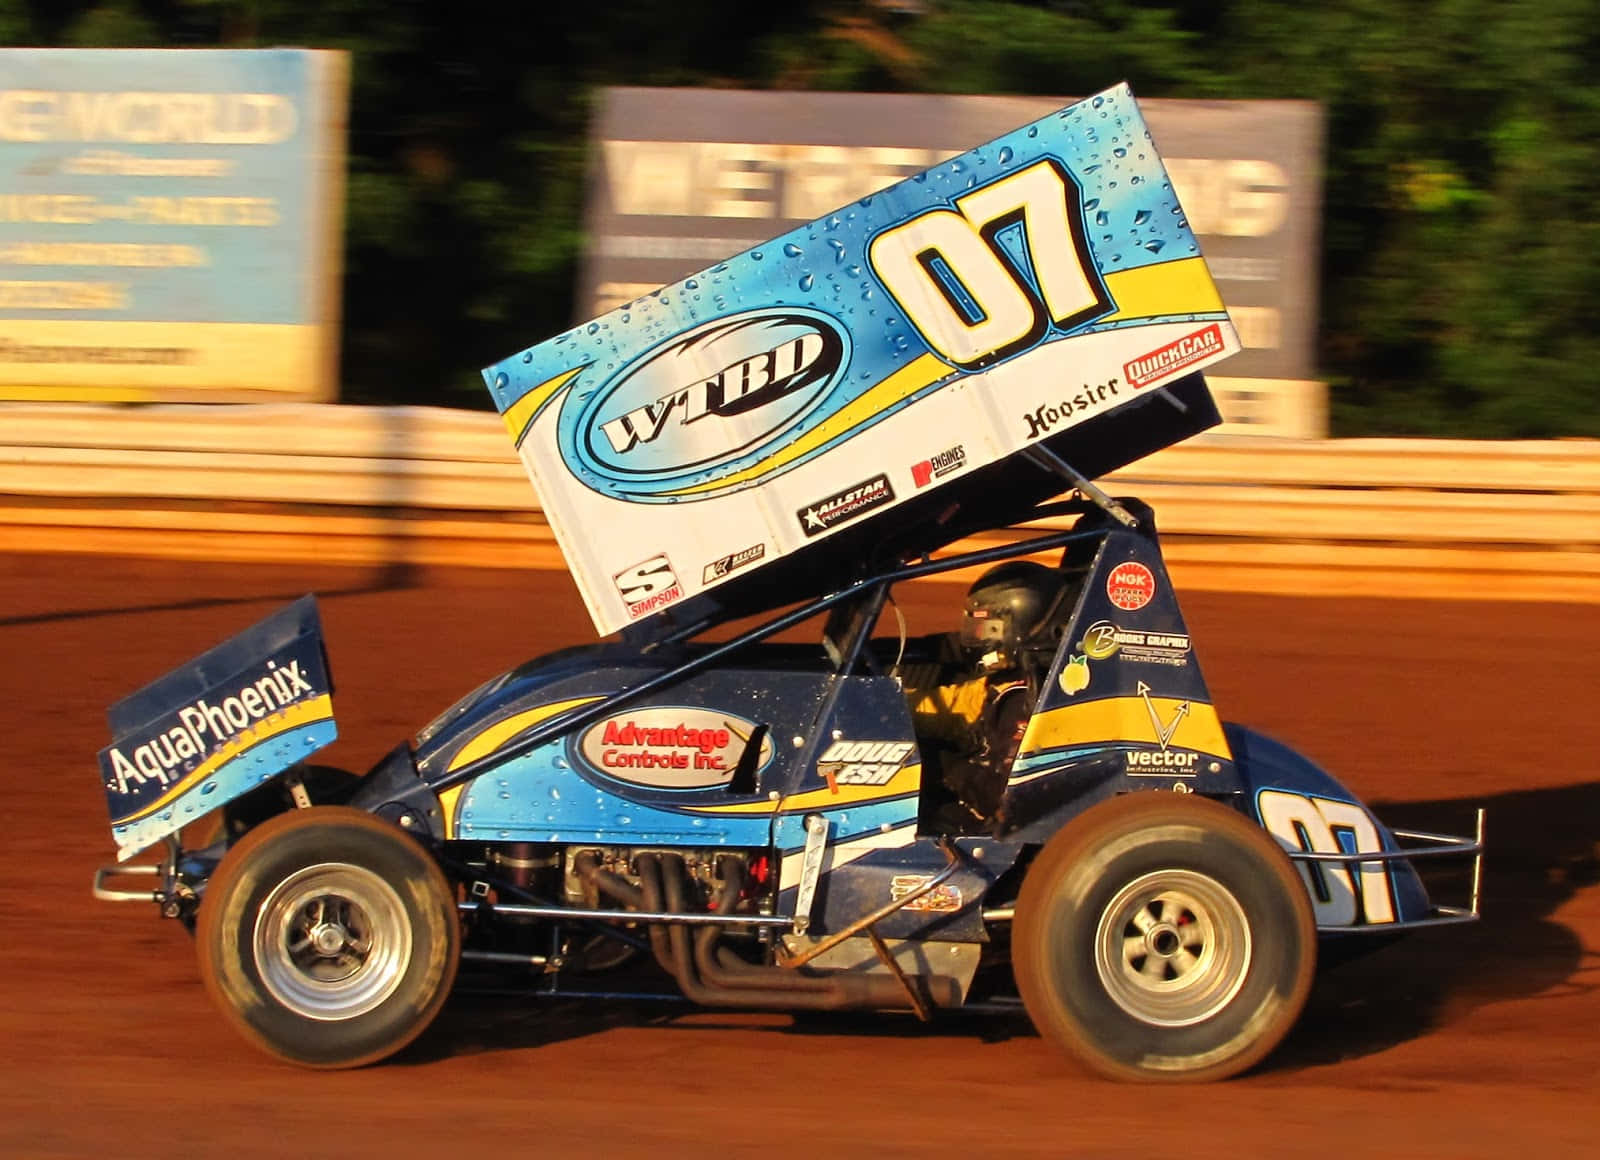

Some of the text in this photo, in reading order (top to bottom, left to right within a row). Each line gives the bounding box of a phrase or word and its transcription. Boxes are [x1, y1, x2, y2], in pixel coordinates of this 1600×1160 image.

[866, 156, 1117, 372] 07
[598, 332, 824, 454] WTBD
[1023, 377, 1119, 440] Hoosier
[931, 445, 966, 471] ENGINES
[818, 479, 885, 514] ALLSTAR
[1115, 573, 1147, 586] NGK
[631, 586, 680, 617] SIMPSON
[109, 660, 312, 794] AquaPhoenix
[602, 721, 730, 753] Advantage
[603, 749, 728, 770] Controls Inc.
[817, 740, 916, 764] DOUG
[1127, 750, 1199, 766] vector
[835, 763, 901, 786] ESH
[1256, 788, 1398, 925] 07
